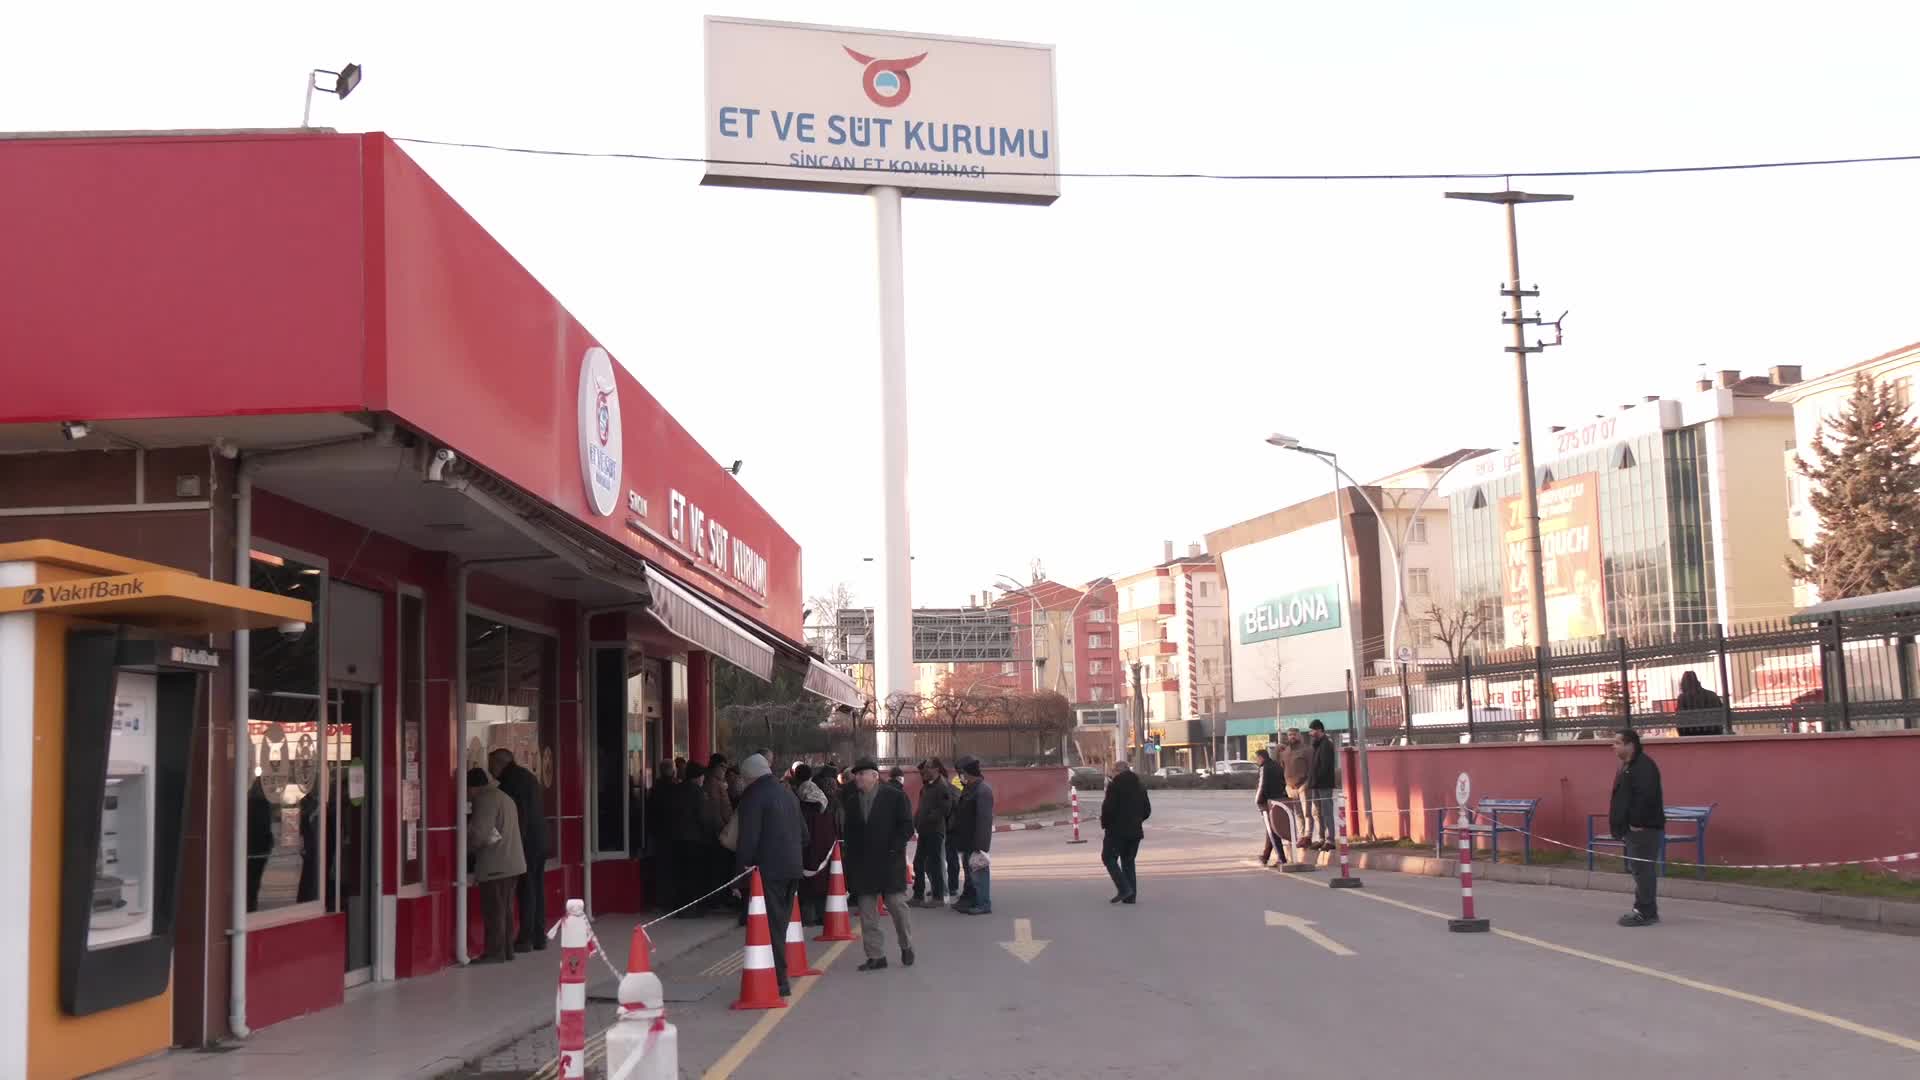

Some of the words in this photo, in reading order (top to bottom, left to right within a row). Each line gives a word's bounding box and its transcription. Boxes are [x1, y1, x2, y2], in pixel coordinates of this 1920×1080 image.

[719, 106, 760, 139] ET
[770, 109, 815, 144] VE
[827, 114, 893, 149] SÜT
[904, 119, 1049, 160] KURUMU
[789, 149, 855, 170] SİNCAN
[863, 158, 884, 171] ET
[888, 159, 985, 179] KOMBİNASI
[670, 488, 686, 544] ET
[689, 502, 705, 558] VE
[732, 535, 768, 597] KURUMU
[49, 577, 144, 603] VakıfBank
[1245, 593, 1329, 634] BELLONA
